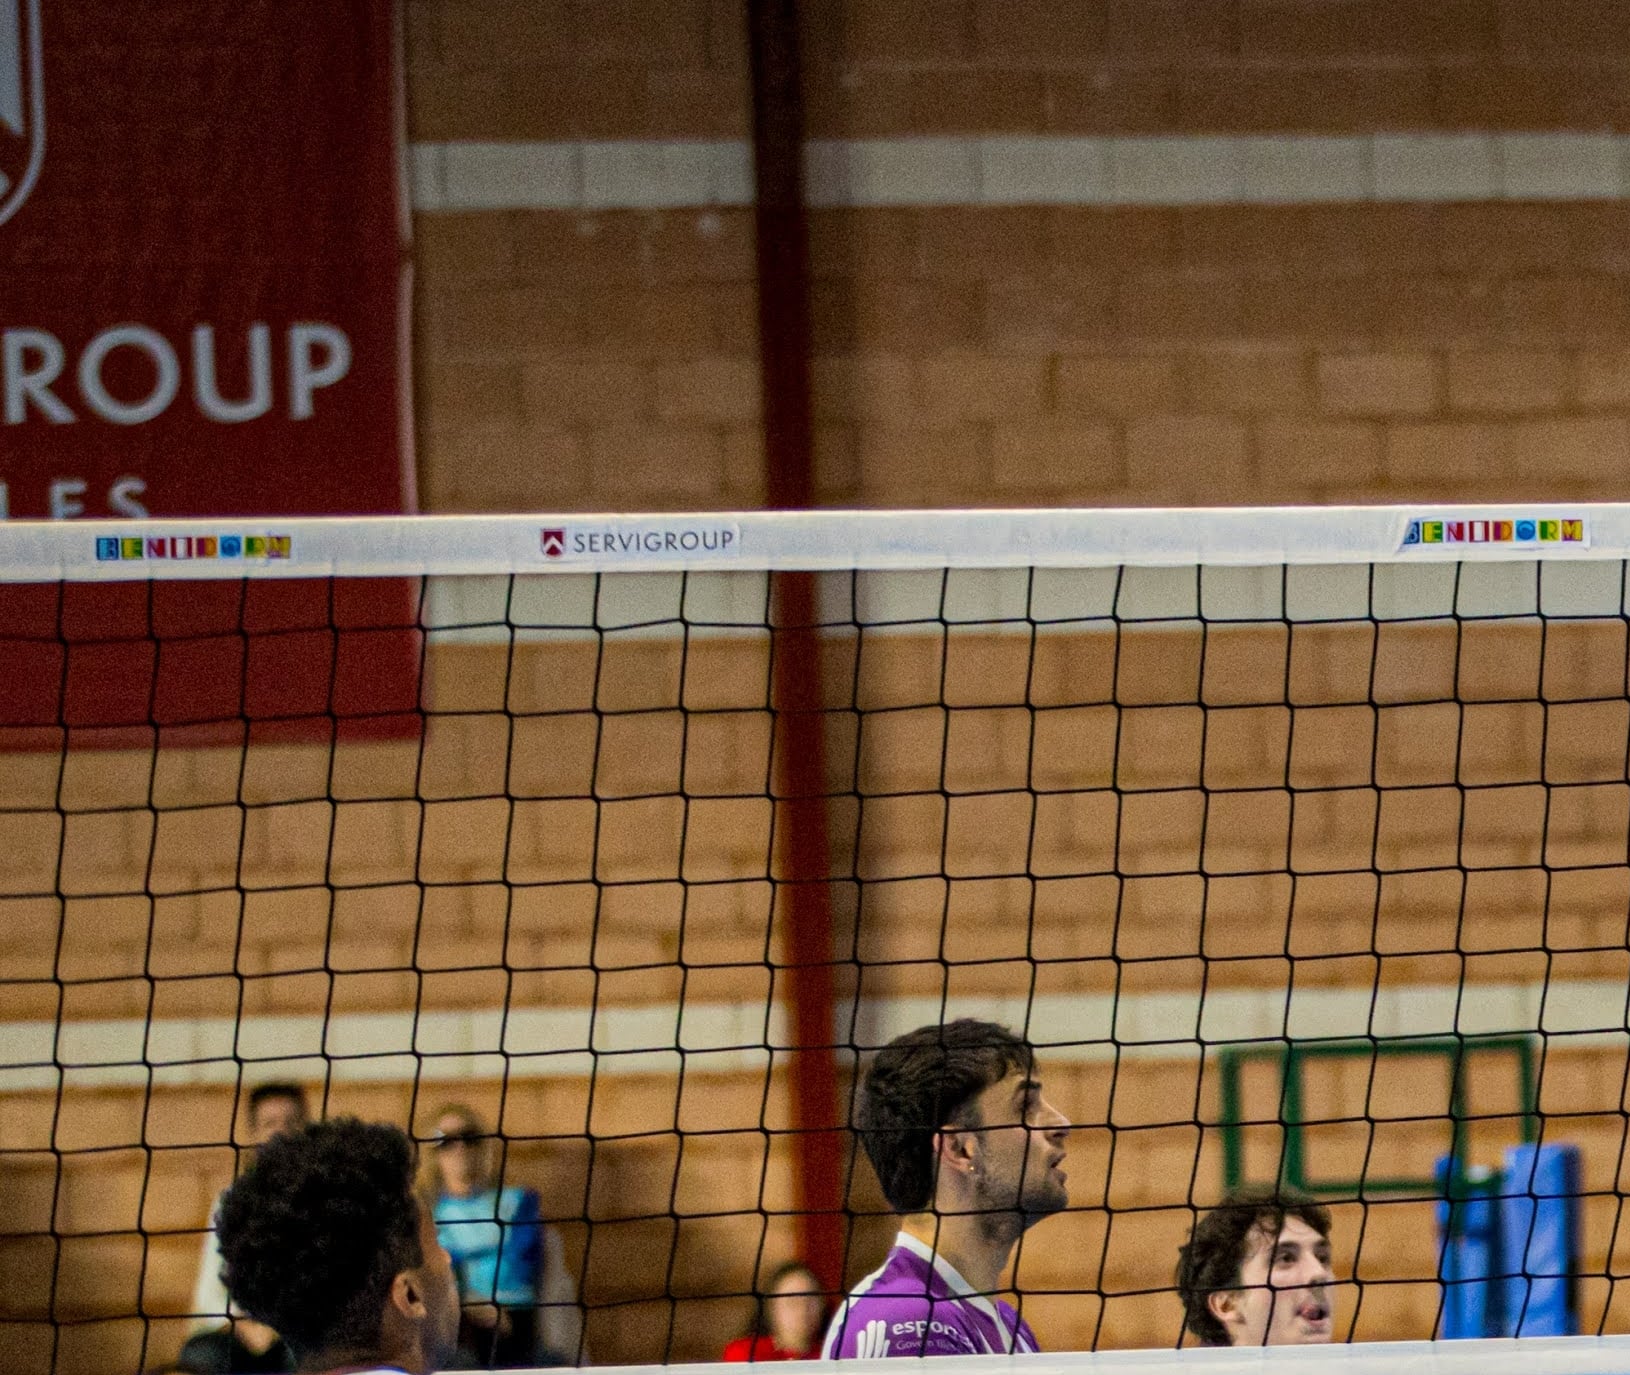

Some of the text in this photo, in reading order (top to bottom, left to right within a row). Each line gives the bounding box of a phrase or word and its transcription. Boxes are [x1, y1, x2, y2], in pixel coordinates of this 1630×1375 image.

[572, 529, 733, 554] SERVIGROUP
[1404, 519, 1583, 545] BENIDORM
[96, 536, 291, 560] BENIDORM
